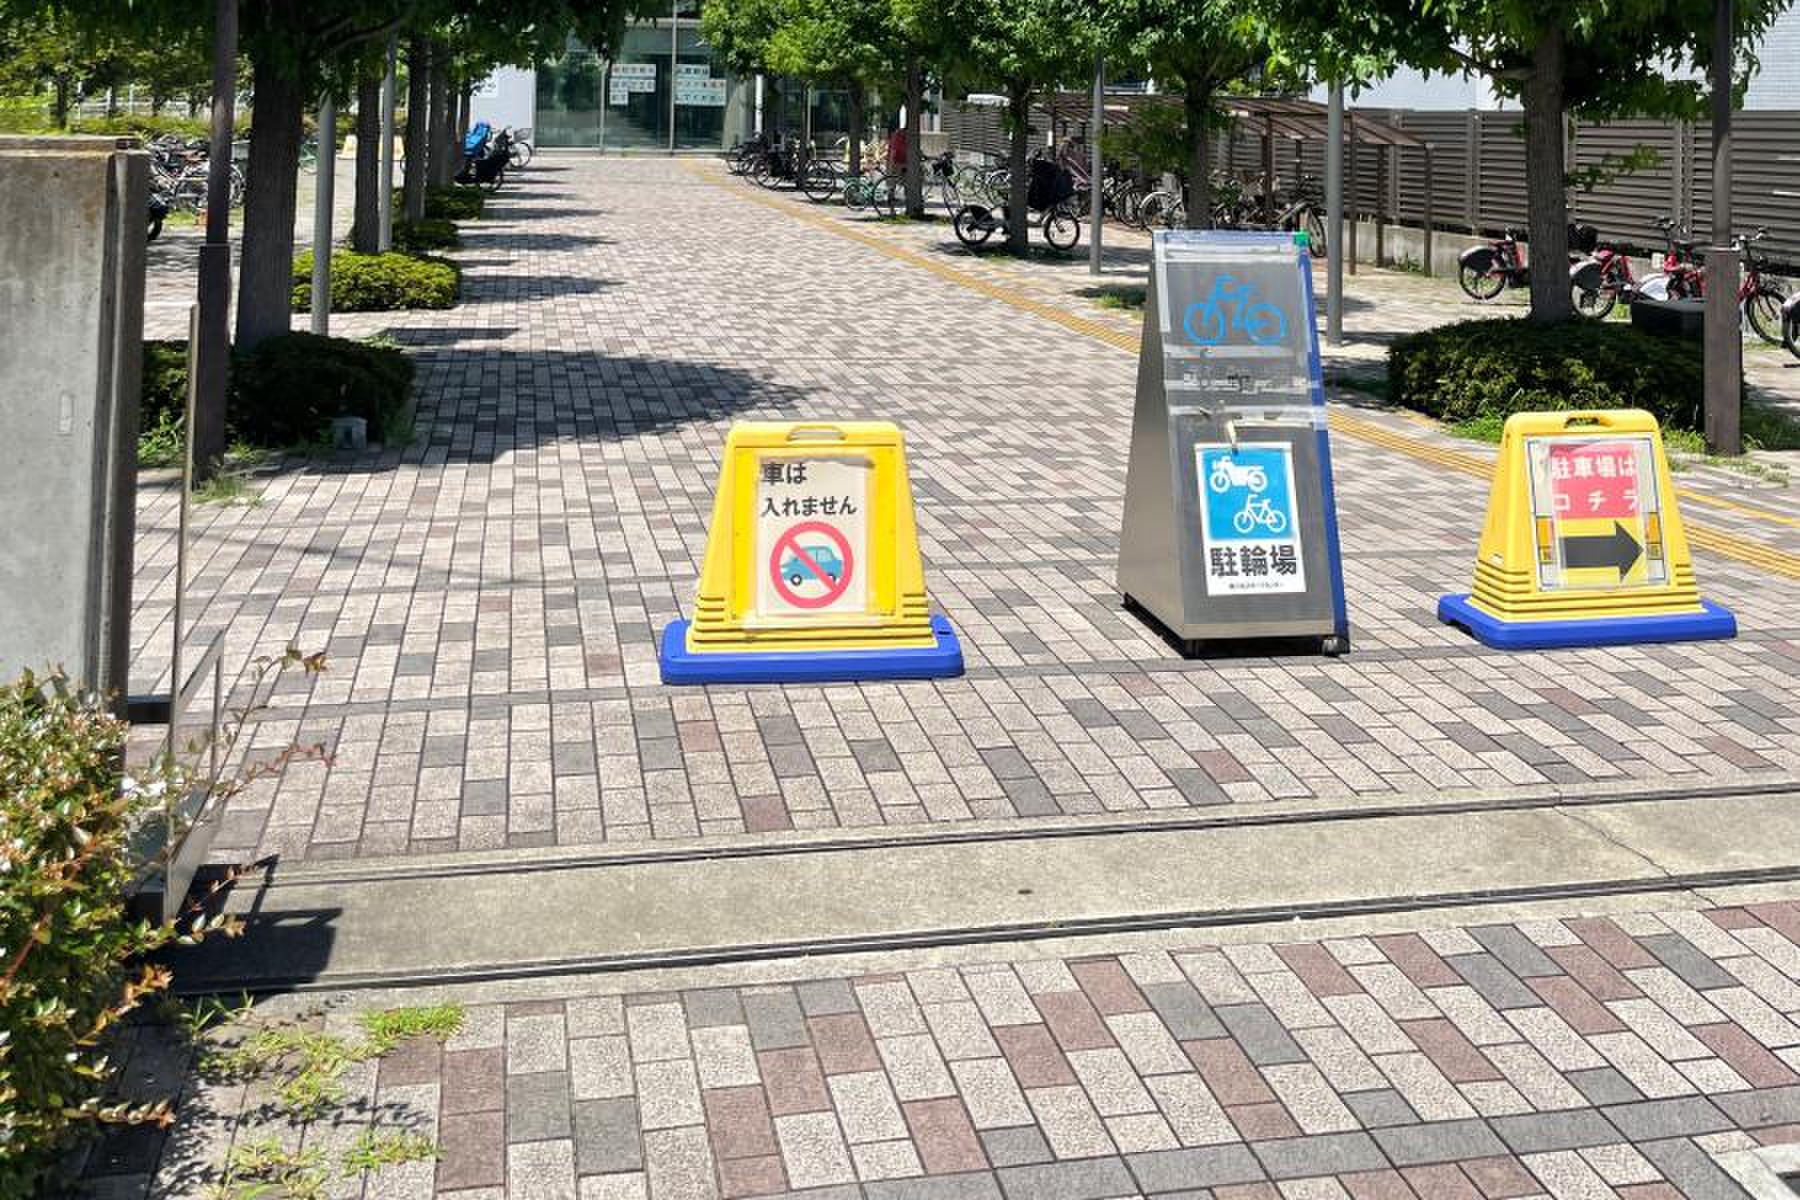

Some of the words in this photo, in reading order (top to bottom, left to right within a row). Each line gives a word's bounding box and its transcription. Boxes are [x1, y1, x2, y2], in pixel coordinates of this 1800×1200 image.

[761, 462, 807, 486] 車は
[1551, 455, 1636, 480] 駐車場は
[761, 496, 858, 518] 入れません
[1210, 544, 1297, 577] 駐輪場
